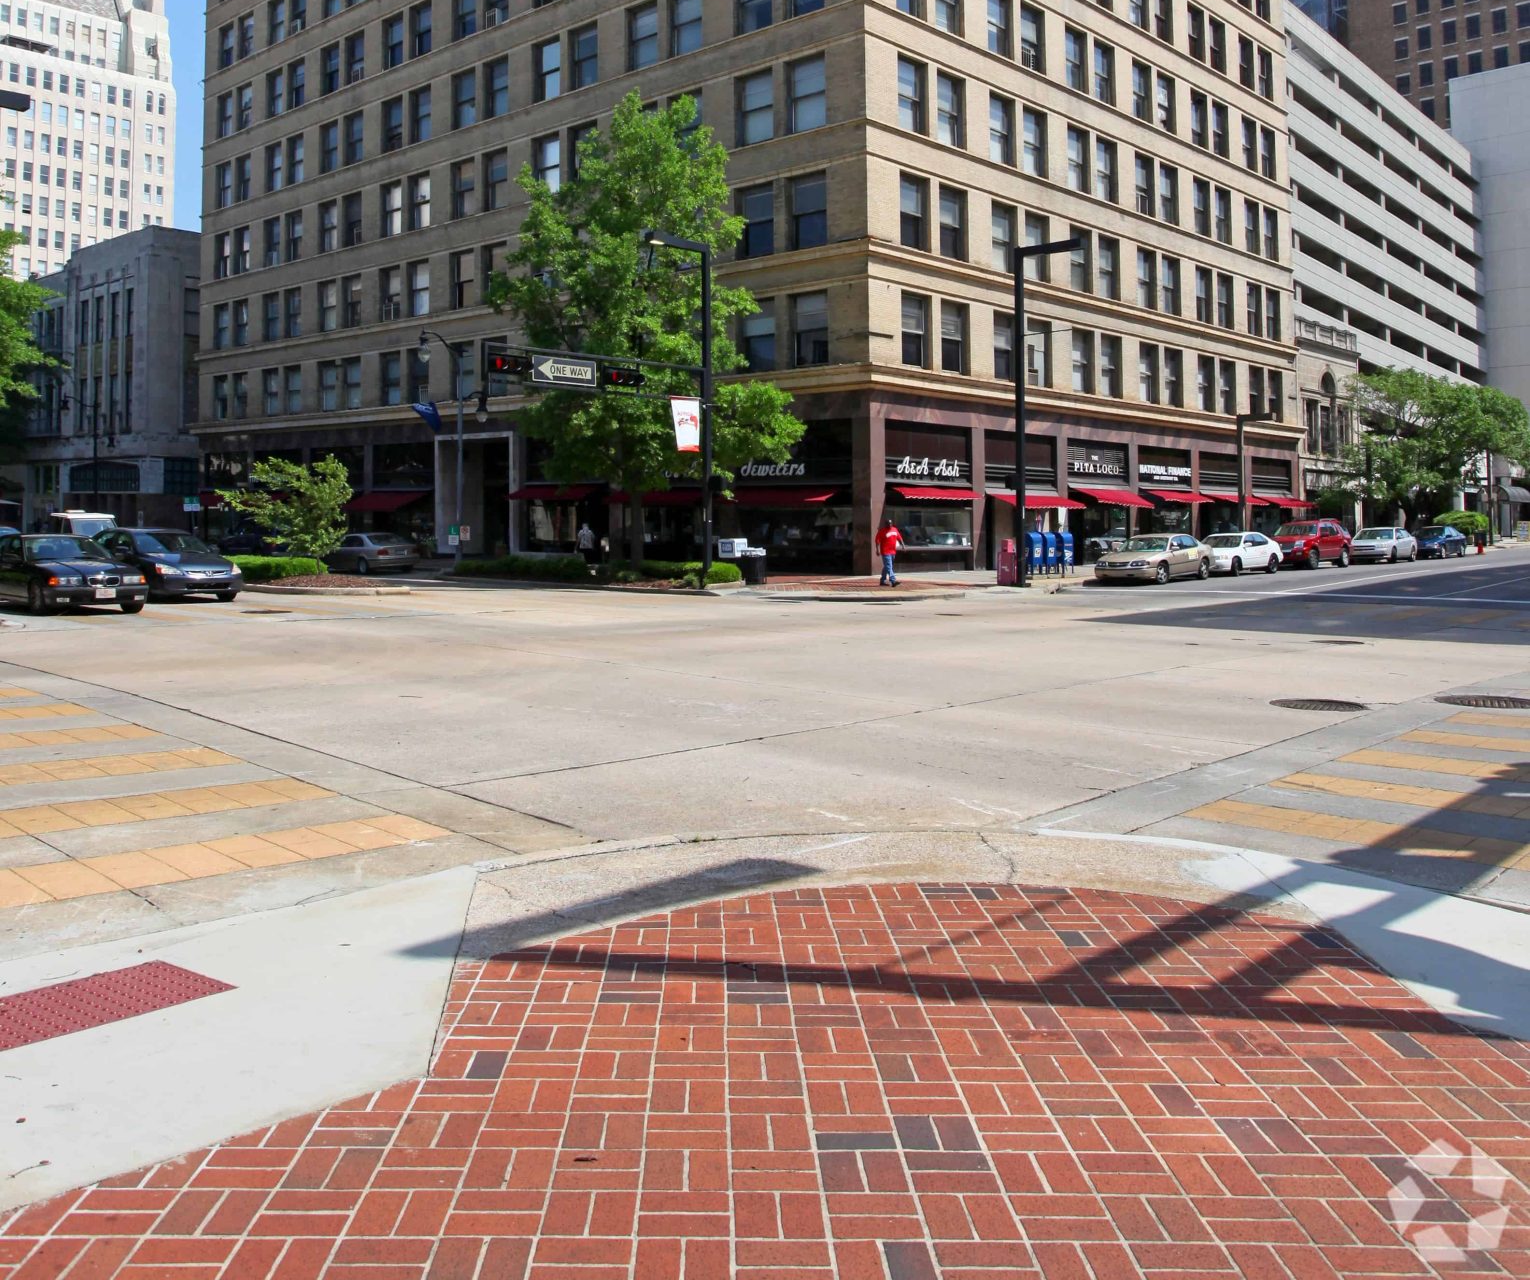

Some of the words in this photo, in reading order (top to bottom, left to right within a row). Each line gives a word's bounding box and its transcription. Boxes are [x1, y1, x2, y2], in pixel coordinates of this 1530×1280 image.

[550, 365, 567, 376] ONE
[569, 368, 589, 378] WAY
[934, 458, 960, 477] Ash
[1074, 462, 1095, 473] PITA
[1096, 463, 1119, 475] LOCO
[1139, 464, 1168, 475] NATIONAL
[1168, 466, 1192, 477] FINANCE
